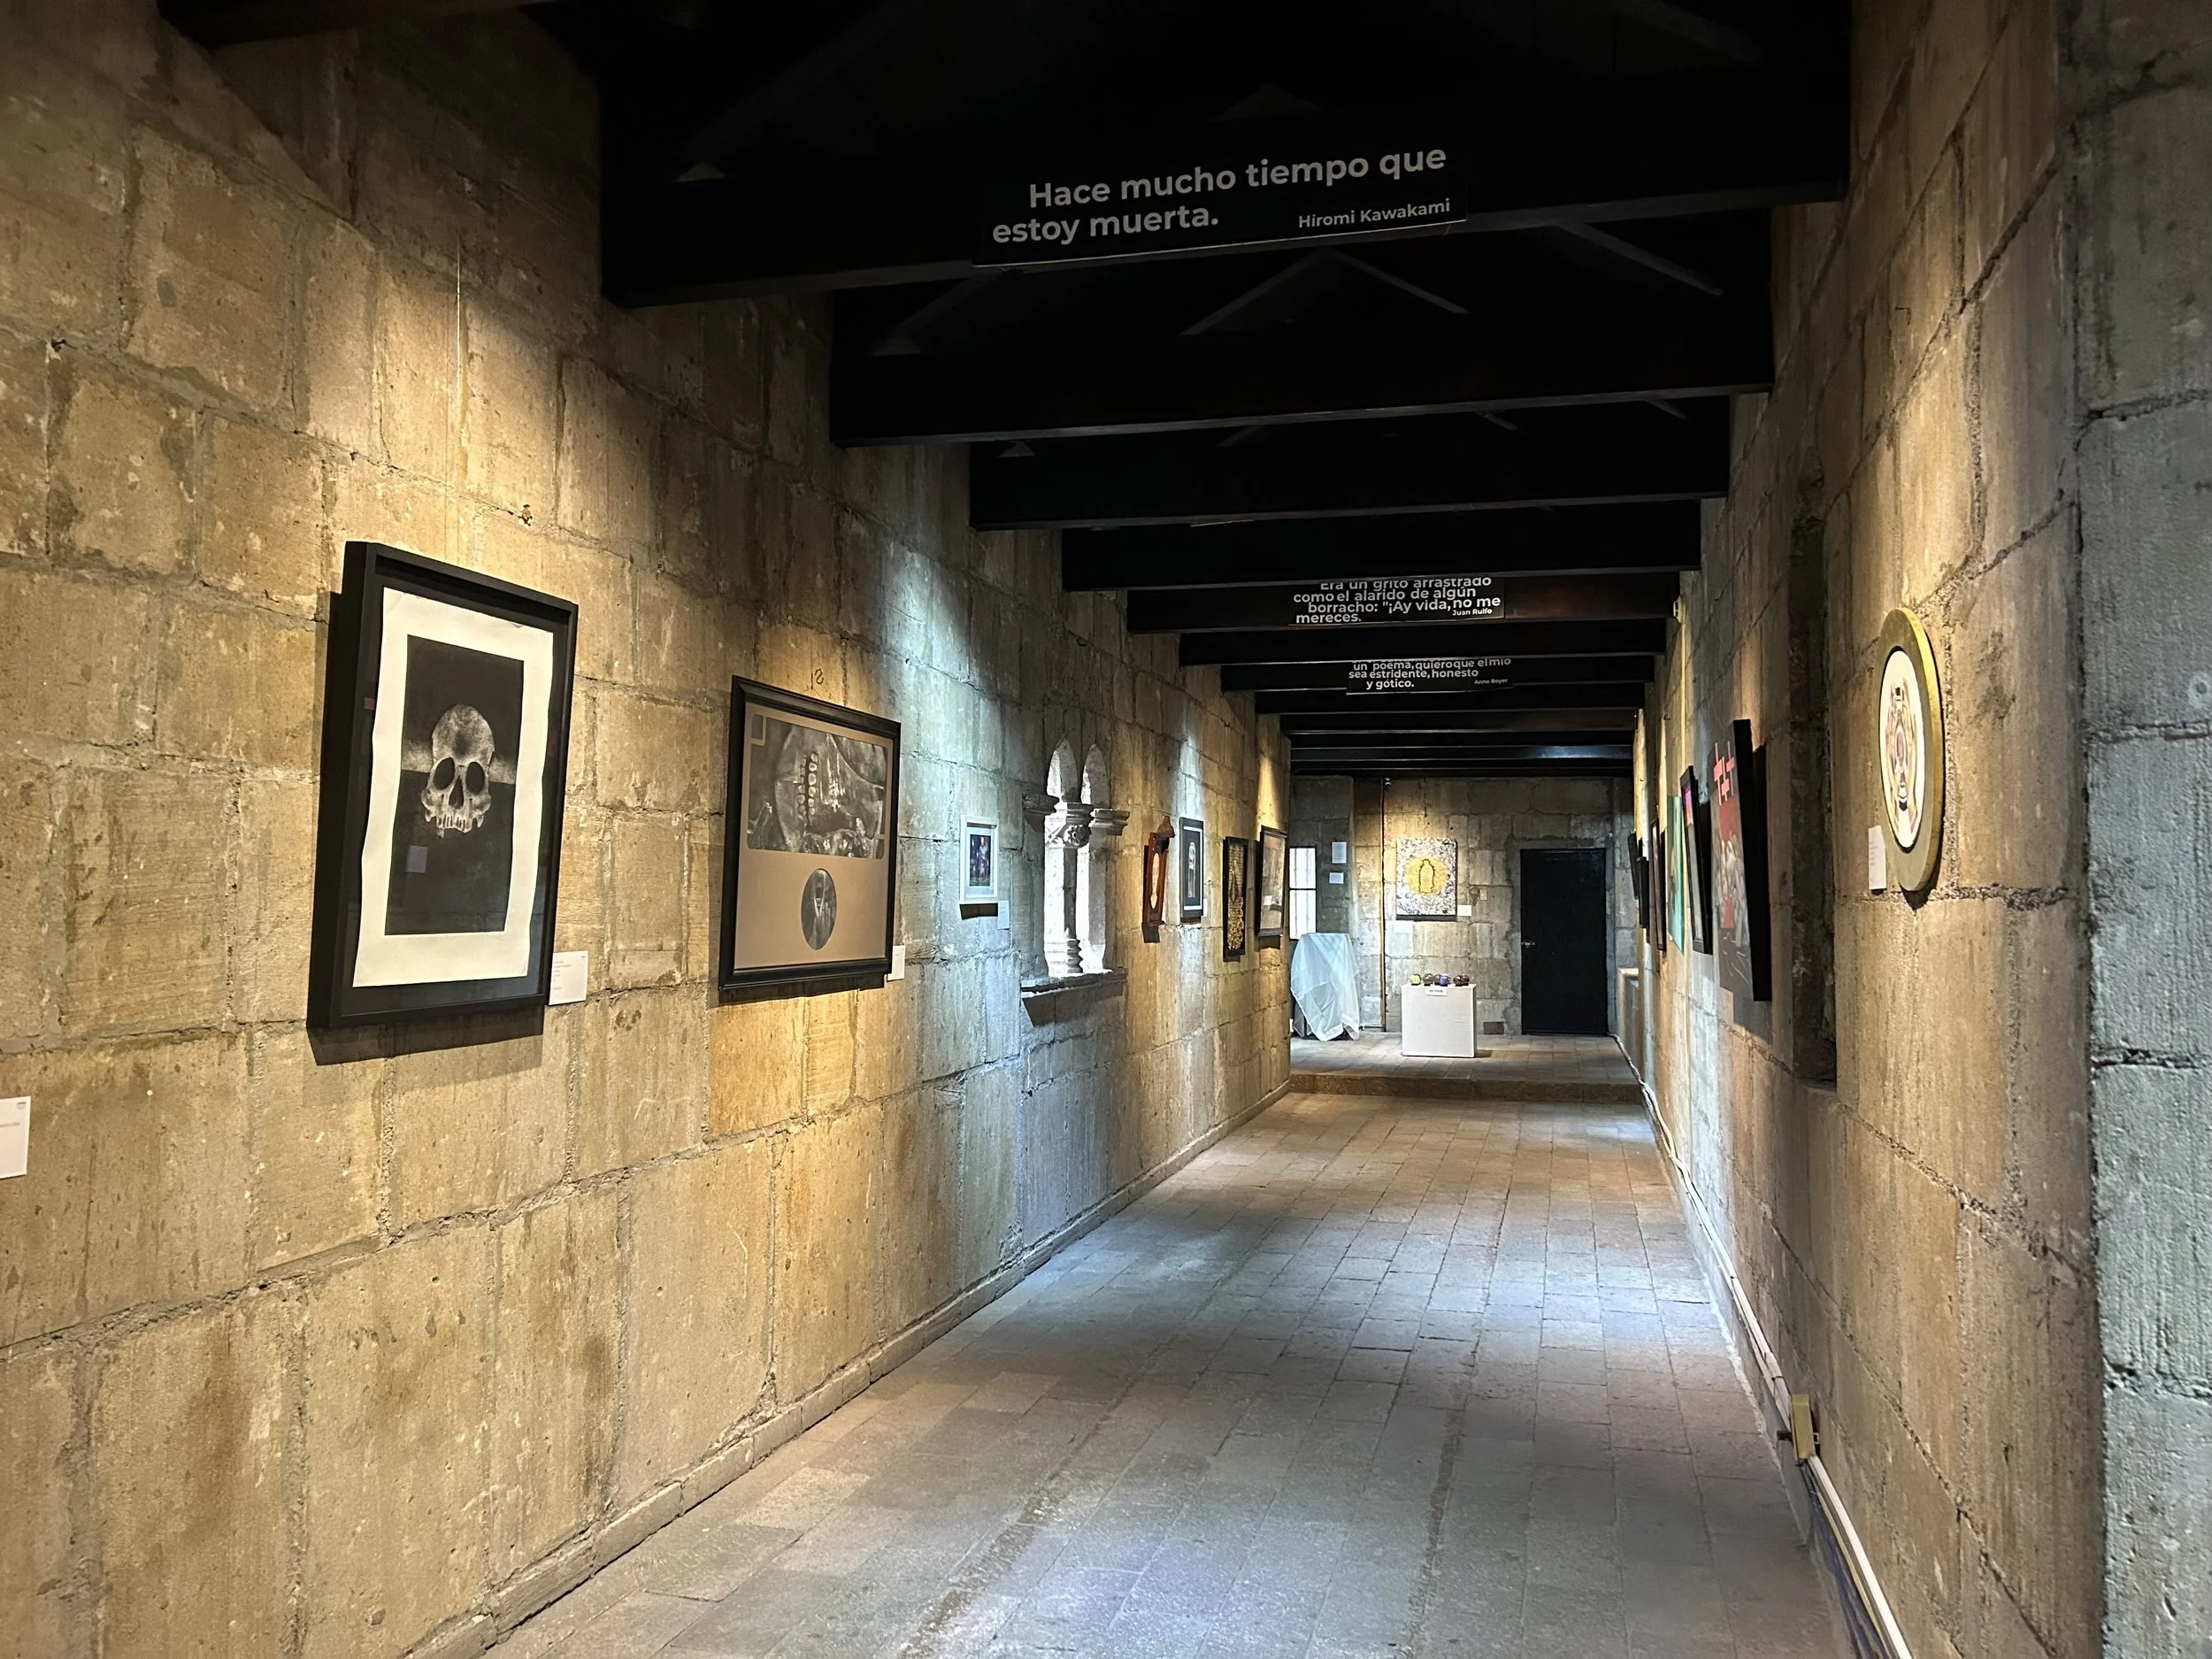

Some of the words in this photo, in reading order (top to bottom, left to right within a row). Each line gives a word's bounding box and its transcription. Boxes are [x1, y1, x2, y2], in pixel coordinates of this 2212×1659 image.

[1028, 181, 1110, 209] Hace
[1120, 165, 1236, 201] mucho
[1245, 157, 1369, 188] tiempo
[1379, 149, 1447, 180] que
[1297, 210, 1356, 229] Hiromi
[1360, 197, 1451, 222] Kawakami
[992, 216, 1079, 246] estoy
[1089, 204, 1219, 237] muerta.
[1414, 577, 1492, 588] arrastrado
[1294, 592, 1334, 603] como
[1337, 591, 1349, 602] el
[1355, 588, 1406, 601] alarido
[1410, 588, 1429, 599] de
[1433, 587, 1477, 600] algún
[1309, 602, 1379, 613] borracho:
[1417, 600, 1451, 611] vida,
[1453, 599, 1472, 608] no
[1477, 596, 1501, 607] me
[1296, 613, 1362, 624] mereces.
[1373, 662, 1415, 672] poema,
[1416, 661, 1454, 671] quiero
[1454, 660, 1475, 670] que
[1369, 670, 1430, 679] estridente,
[1432, 669, 1479, 678] honesto
[1366, 681, 1373, 690] y
[1376, 679, 1415, 689] gótico.
